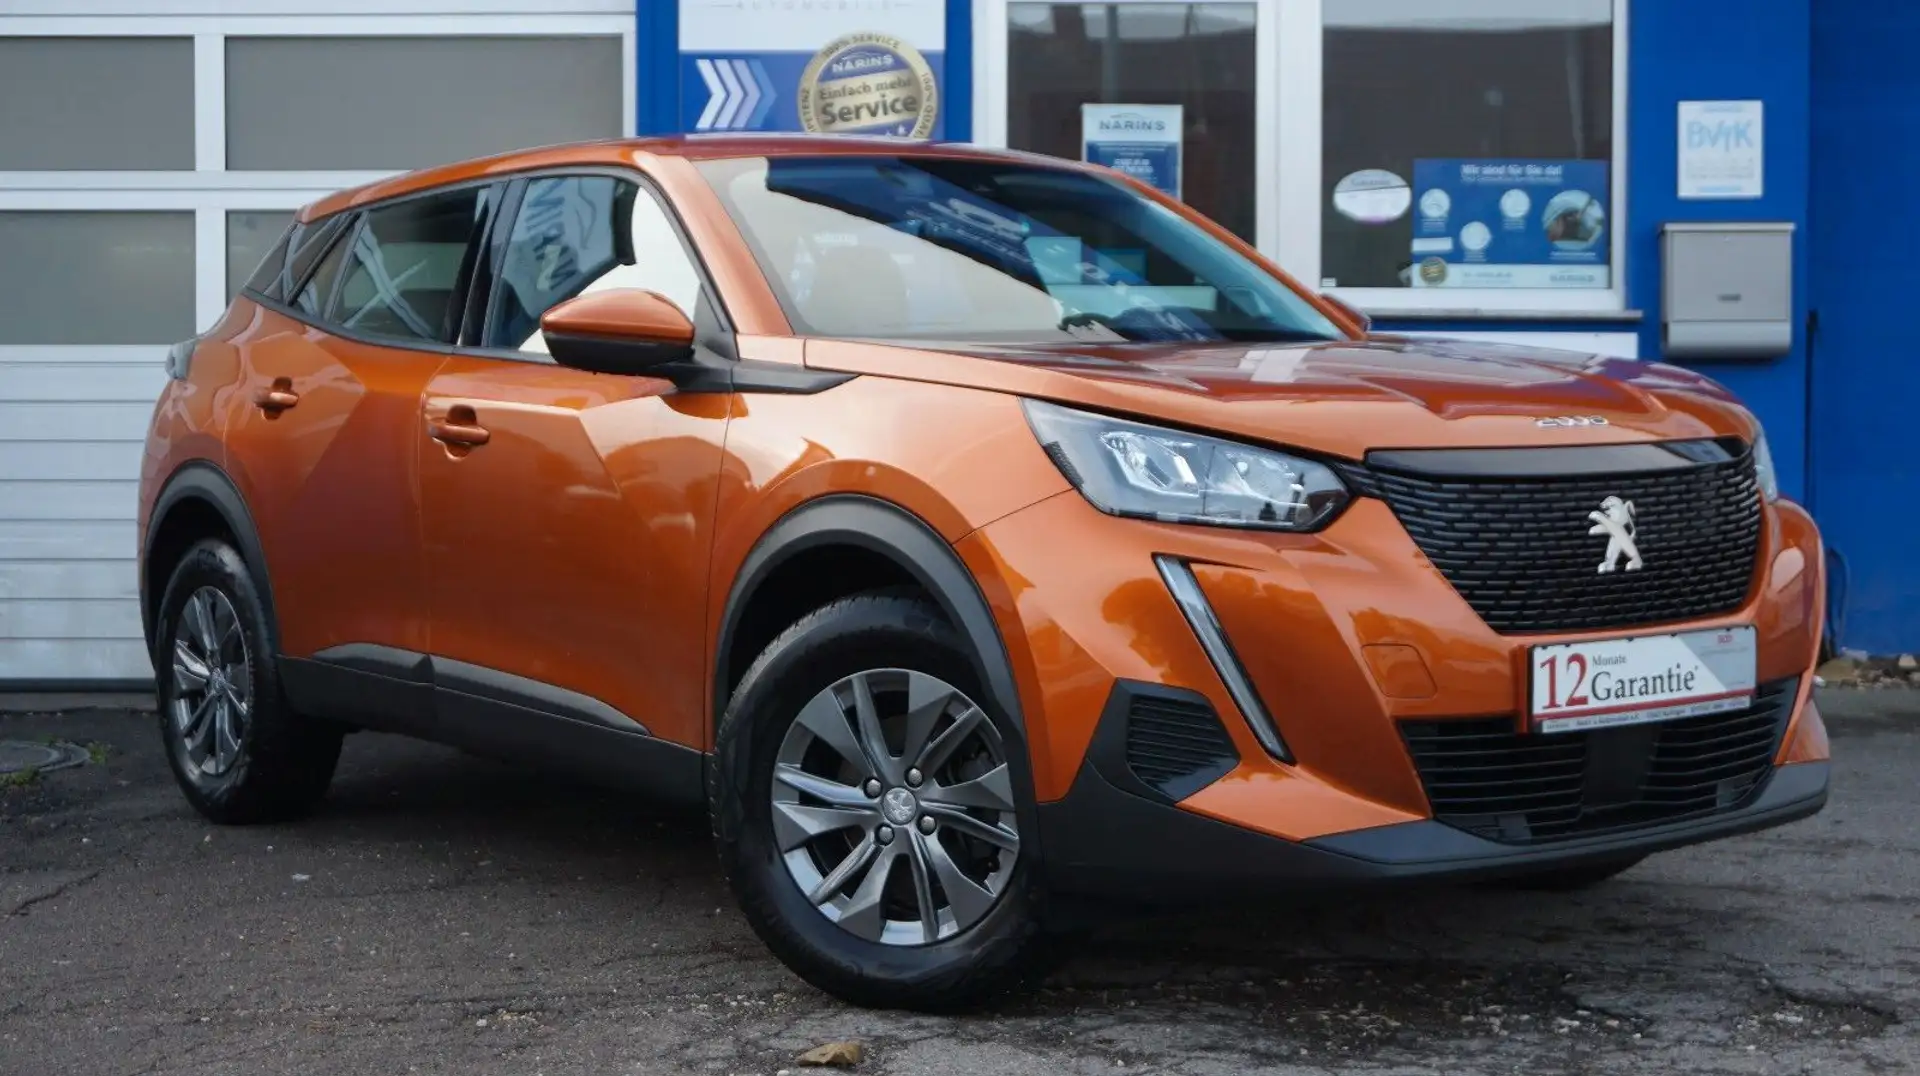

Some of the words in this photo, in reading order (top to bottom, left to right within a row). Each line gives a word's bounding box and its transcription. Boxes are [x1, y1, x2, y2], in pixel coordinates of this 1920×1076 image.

[852, 34, 900, 50] SERVICE
[832, 55, 893, 72] NARINS
[820, 82, 871, 100] Einfach
[875, 76, 913, 92] mehr
[820, 94, 918, 126] Service
[1099, 120, 1166, 131] NARINS
[1540, 652, 1589, 710] 12
[1592, 653, 1627, 667] Monate
